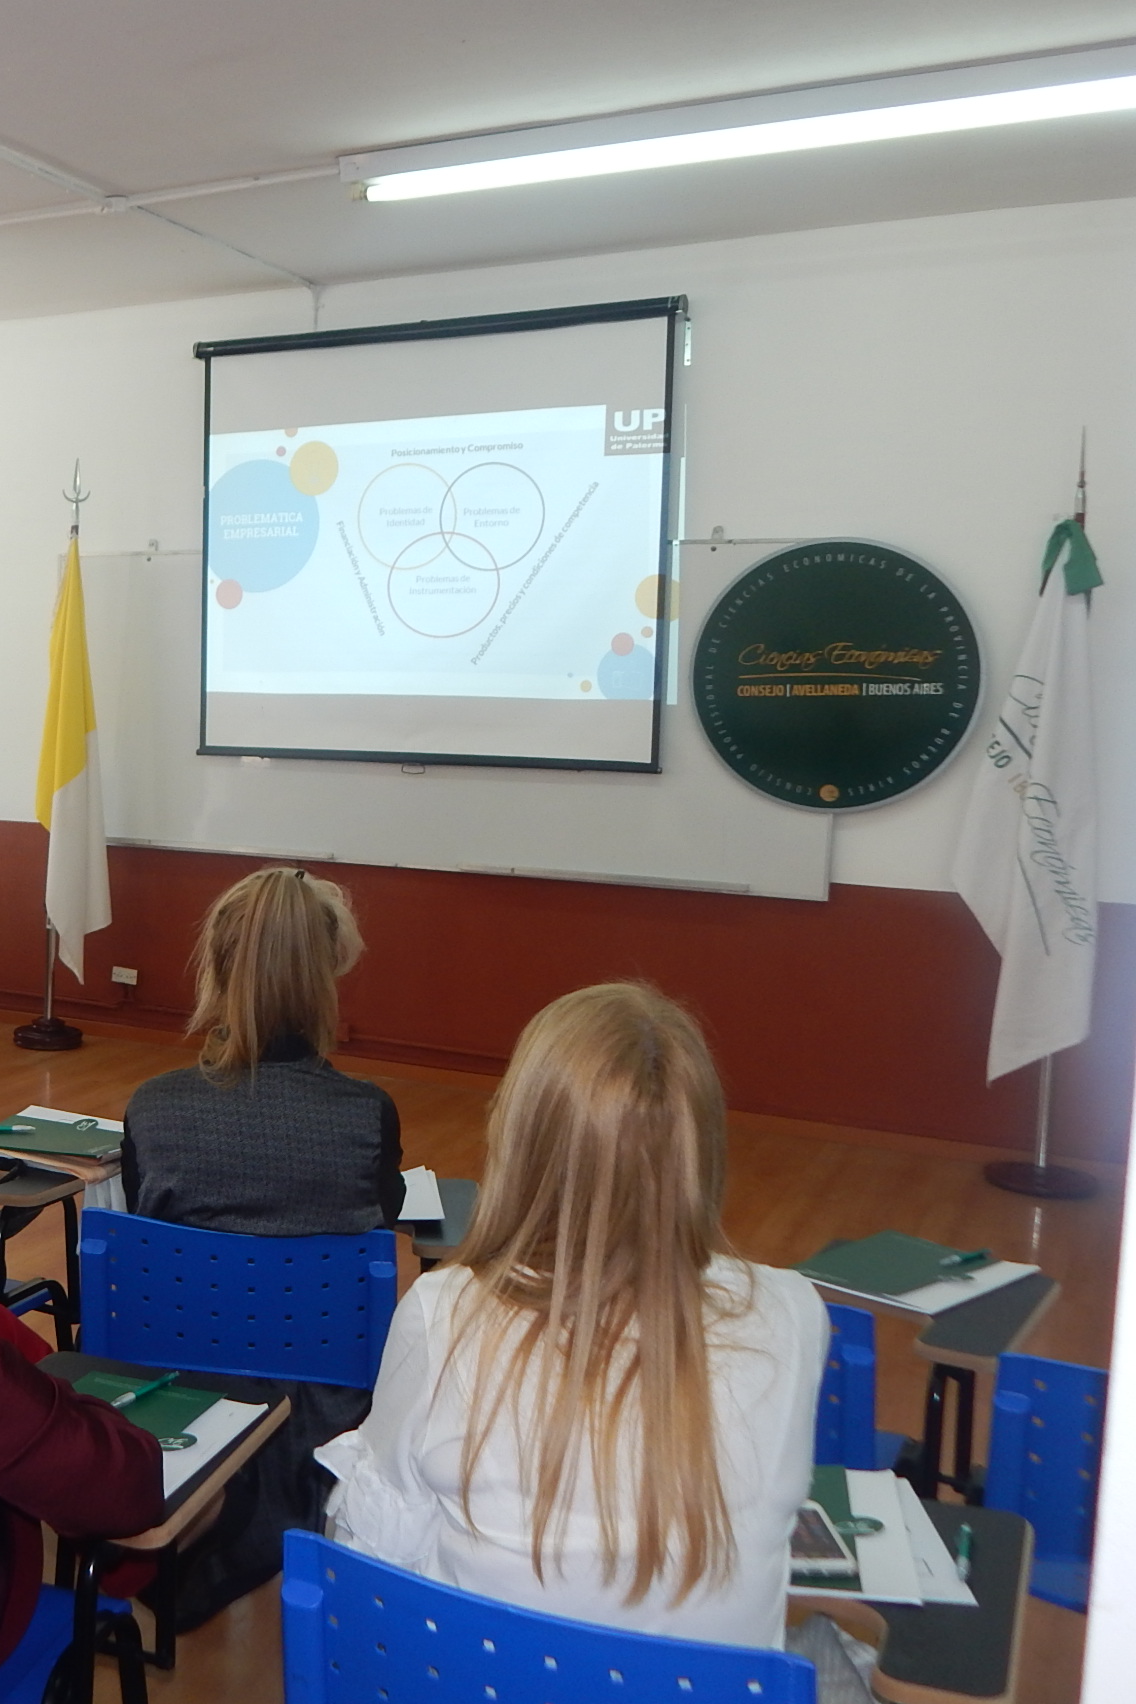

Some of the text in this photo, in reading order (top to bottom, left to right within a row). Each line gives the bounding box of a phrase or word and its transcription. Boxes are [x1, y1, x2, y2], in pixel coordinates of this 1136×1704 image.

[614, 408, 665, 432] UP
[391, 446, 460, 457] Posicionamiento
[467, 441, 524, 453] Compromiso
[379, 506, 433, 516] Problemas de
[463, 506, 520, 516] Problemas de
[220, 511, 303, 526] PROBLEMATICA
[386, 517, 425, 527] Identidad
[474, 519, 509, 528] Entorno
[223, 526, 299, 539] EMPRESARIAL
[499, 593, 522, 624] precios
[522, 541, 557, 590] condiciones
[562, 480, 599, 533] competencia
[415, 574, 470, 583] Problemas de
[737, 683, 944, 697] CONSEJO AVELLANEDA BUENOS AIRES
